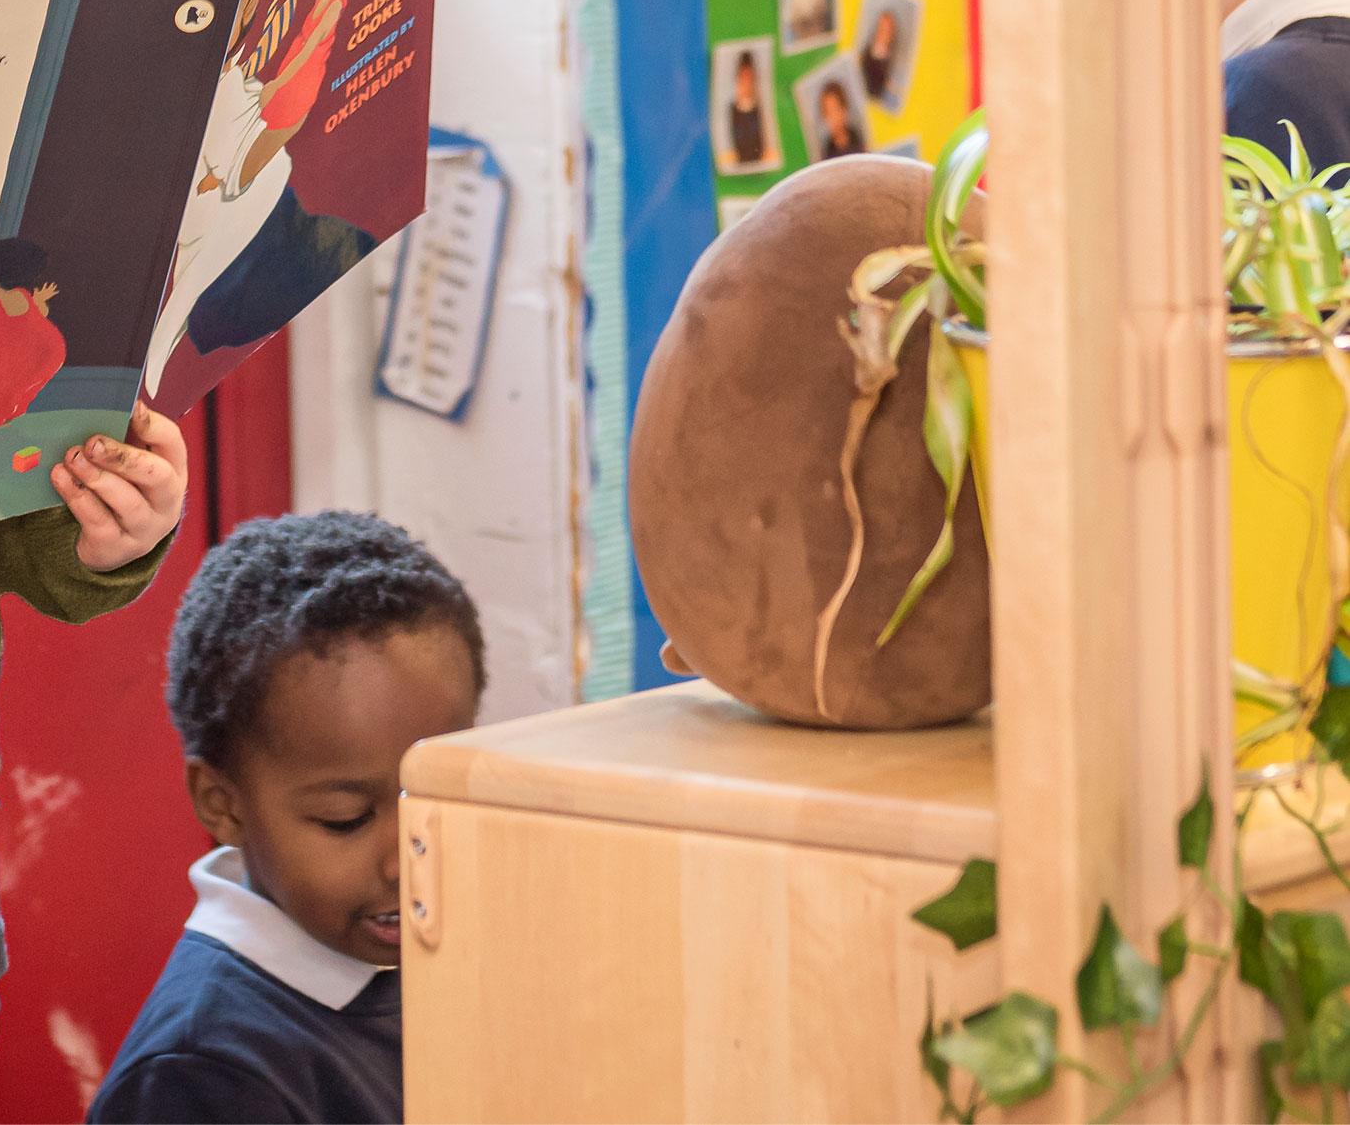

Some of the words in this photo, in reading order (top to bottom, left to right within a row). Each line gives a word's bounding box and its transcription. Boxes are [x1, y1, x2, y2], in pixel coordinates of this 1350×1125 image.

[324, 50, 417, 134] OXENBURY
[331, 28, 399, 92] ILLUSTRATED
[400, 16, 415, 36] BY
[345, 45, 398, 98] HELEN
